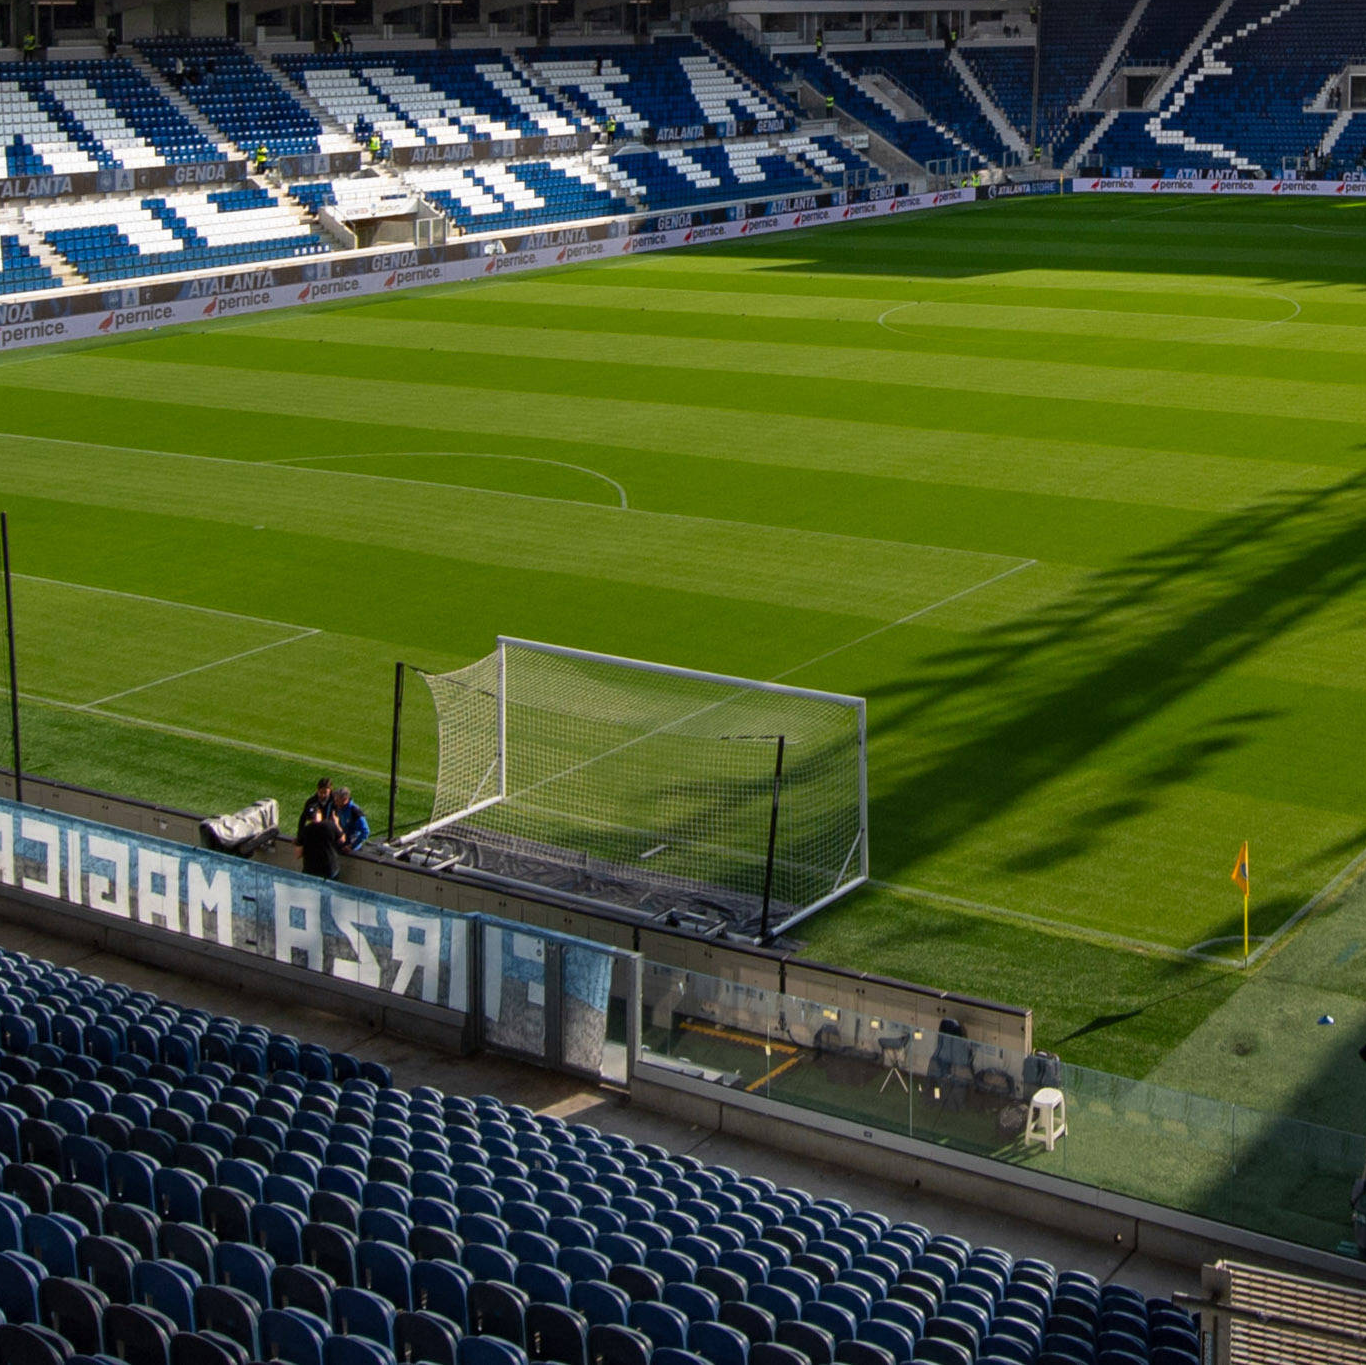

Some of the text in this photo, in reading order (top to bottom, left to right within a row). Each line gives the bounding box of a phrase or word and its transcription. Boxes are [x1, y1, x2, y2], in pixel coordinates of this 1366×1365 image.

[655, 119, 785, 141] ATALANTA GENOA
[411, 137, 579, 163] ATALANTA GENOA
[175, 164, 226, 183] GENOA
[868, 183, 895, 201] GENOA
[997, 183, 1031, 195] ATALANTA
[770, 195, 817, 215] ATALANTA
[657, 212, 692, 231] GENOA
[526, 227, 588, 249] ATALANTA
[632, 234, 668, 251] pernice.
[692, 225, 727, 241] pernice.
[371, 249, 419, 272] GENOA
[566, 242, 604, 260] pernice.
[496, 253, 538, 270] pernice.
[188, 269, 276, 299] ATALANTA
[396, 265, 443, 286] pernice.
[311, 277, 361, 296] pernice.
[218, 292, 272, 314] pernice.
[115, 304, 176, 329] pernice.
[1, 320, 68, 346] pernice.
